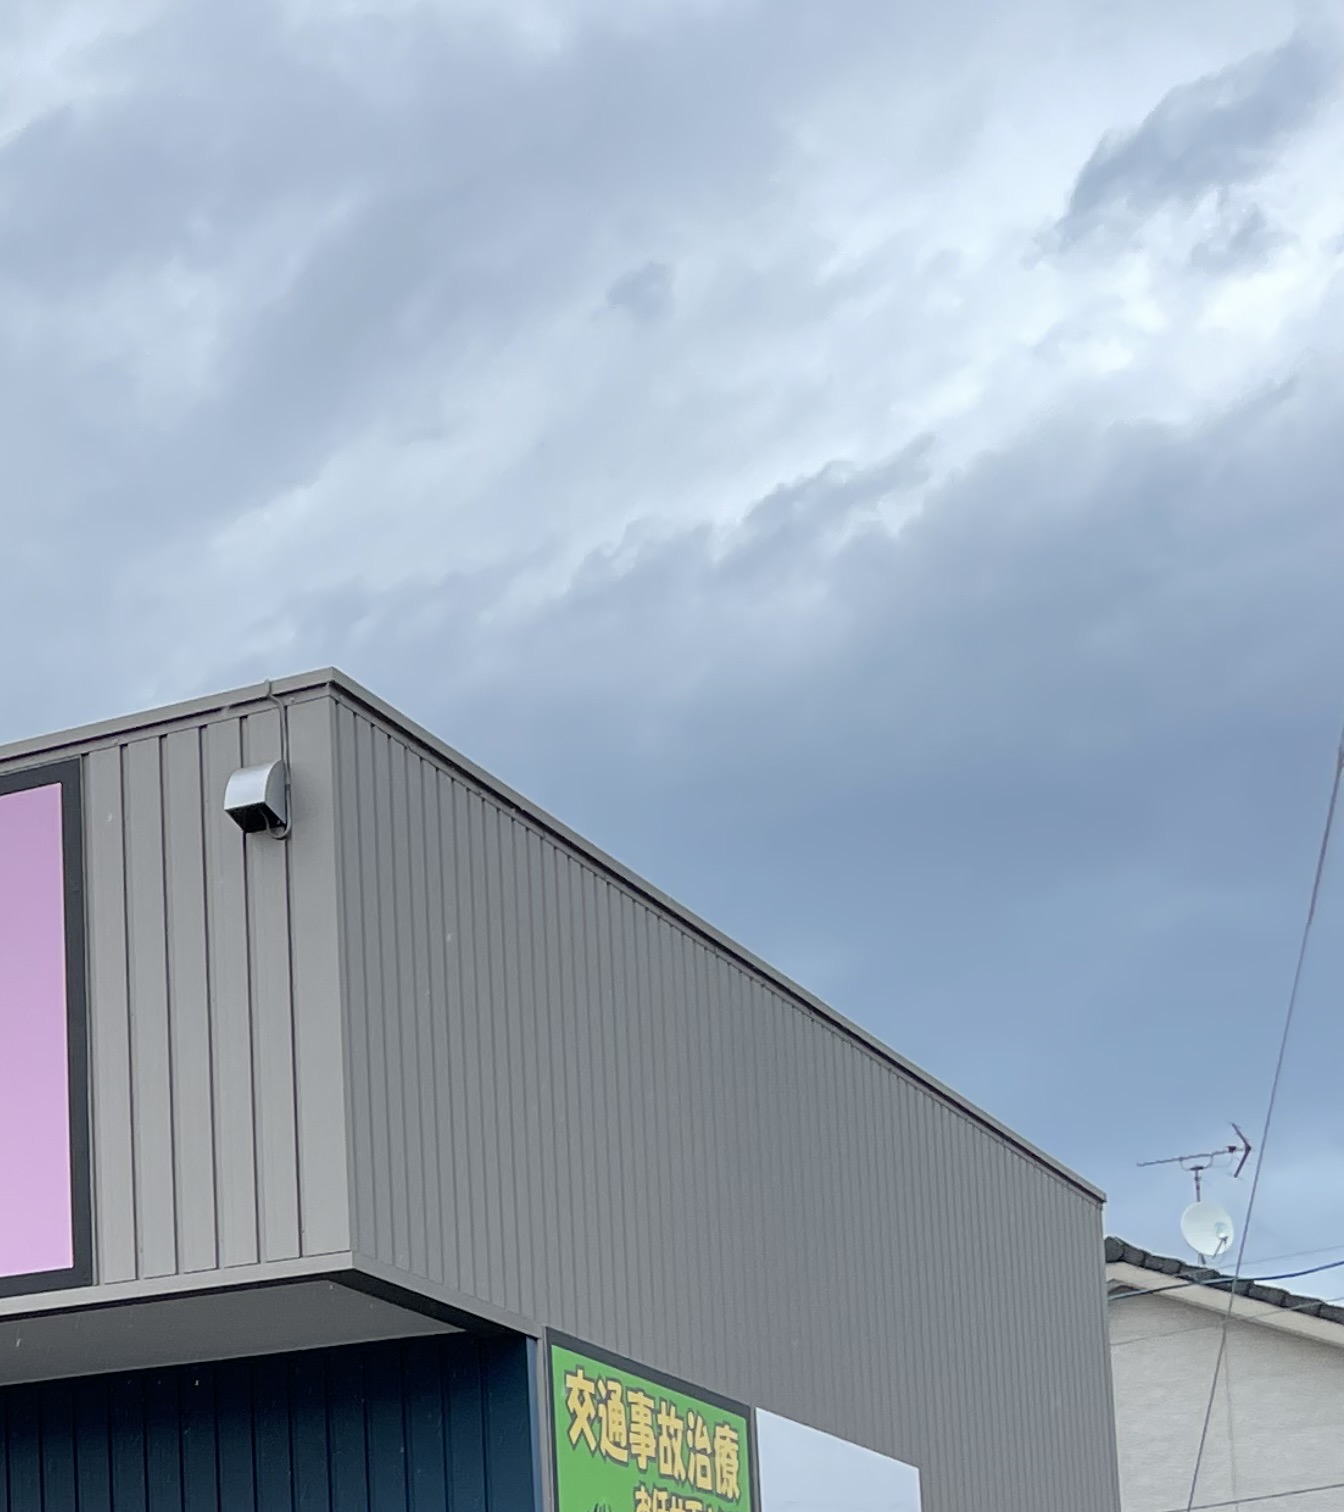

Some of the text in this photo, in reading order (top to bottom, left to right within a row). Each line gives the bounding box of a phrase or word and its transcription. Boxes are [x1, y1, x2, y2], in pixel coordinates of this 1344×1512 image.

[564, 1367, 741, 1501] 交通事故治療
